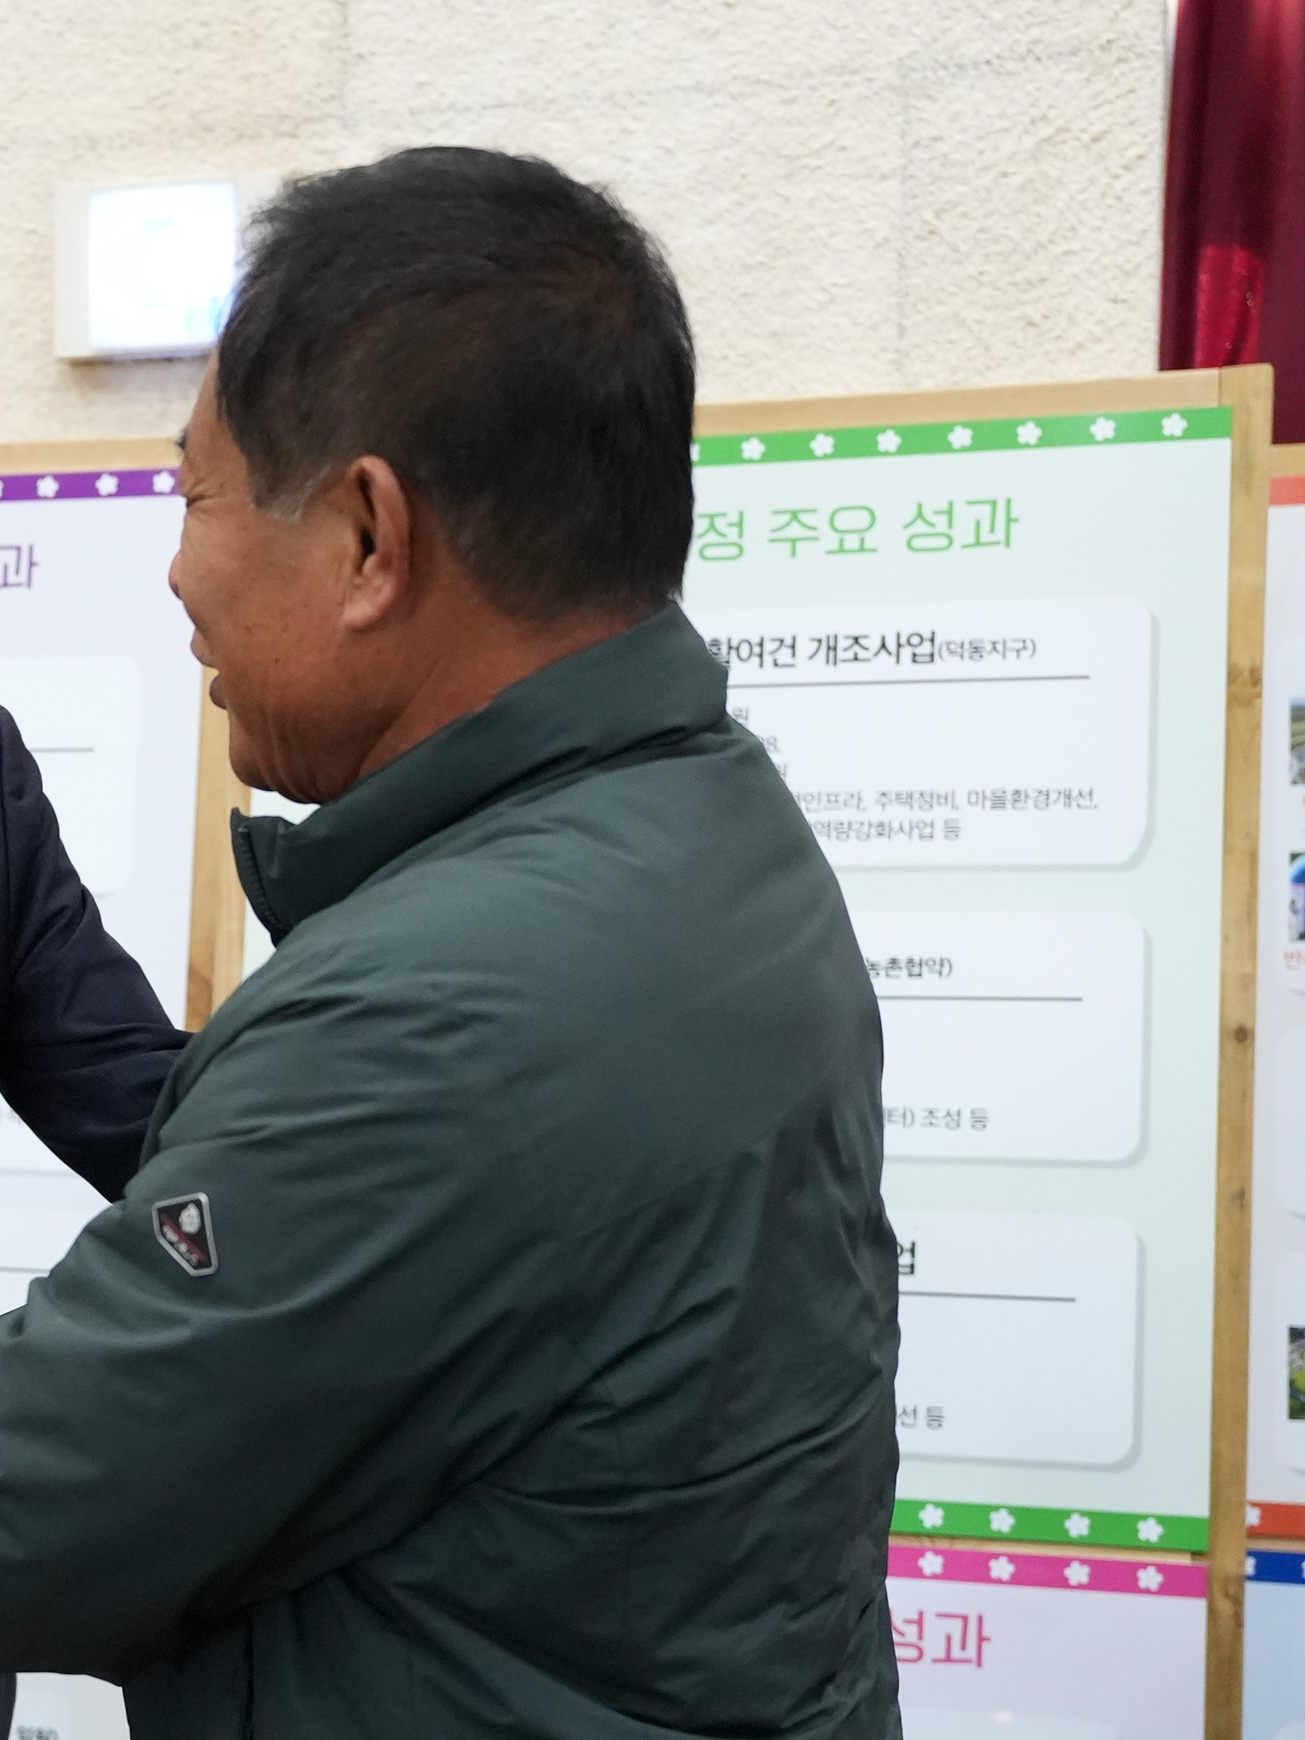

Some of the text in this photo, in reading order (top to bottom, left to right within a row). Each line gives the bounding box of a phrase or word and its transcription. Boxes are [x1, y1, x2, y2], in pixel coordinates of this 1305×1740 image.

[767, 504, 878, 558] 주요
[902, 497, 1020, 552] 성과
[794, 790, 867, 813] 인프라,
[943, 818, 962, 841] 등
[882, 1107, 989, 1132] 터) 조성 등
[926, 1405, 944, 1431] 등
[891, 1609, 992, 1669] 성과
